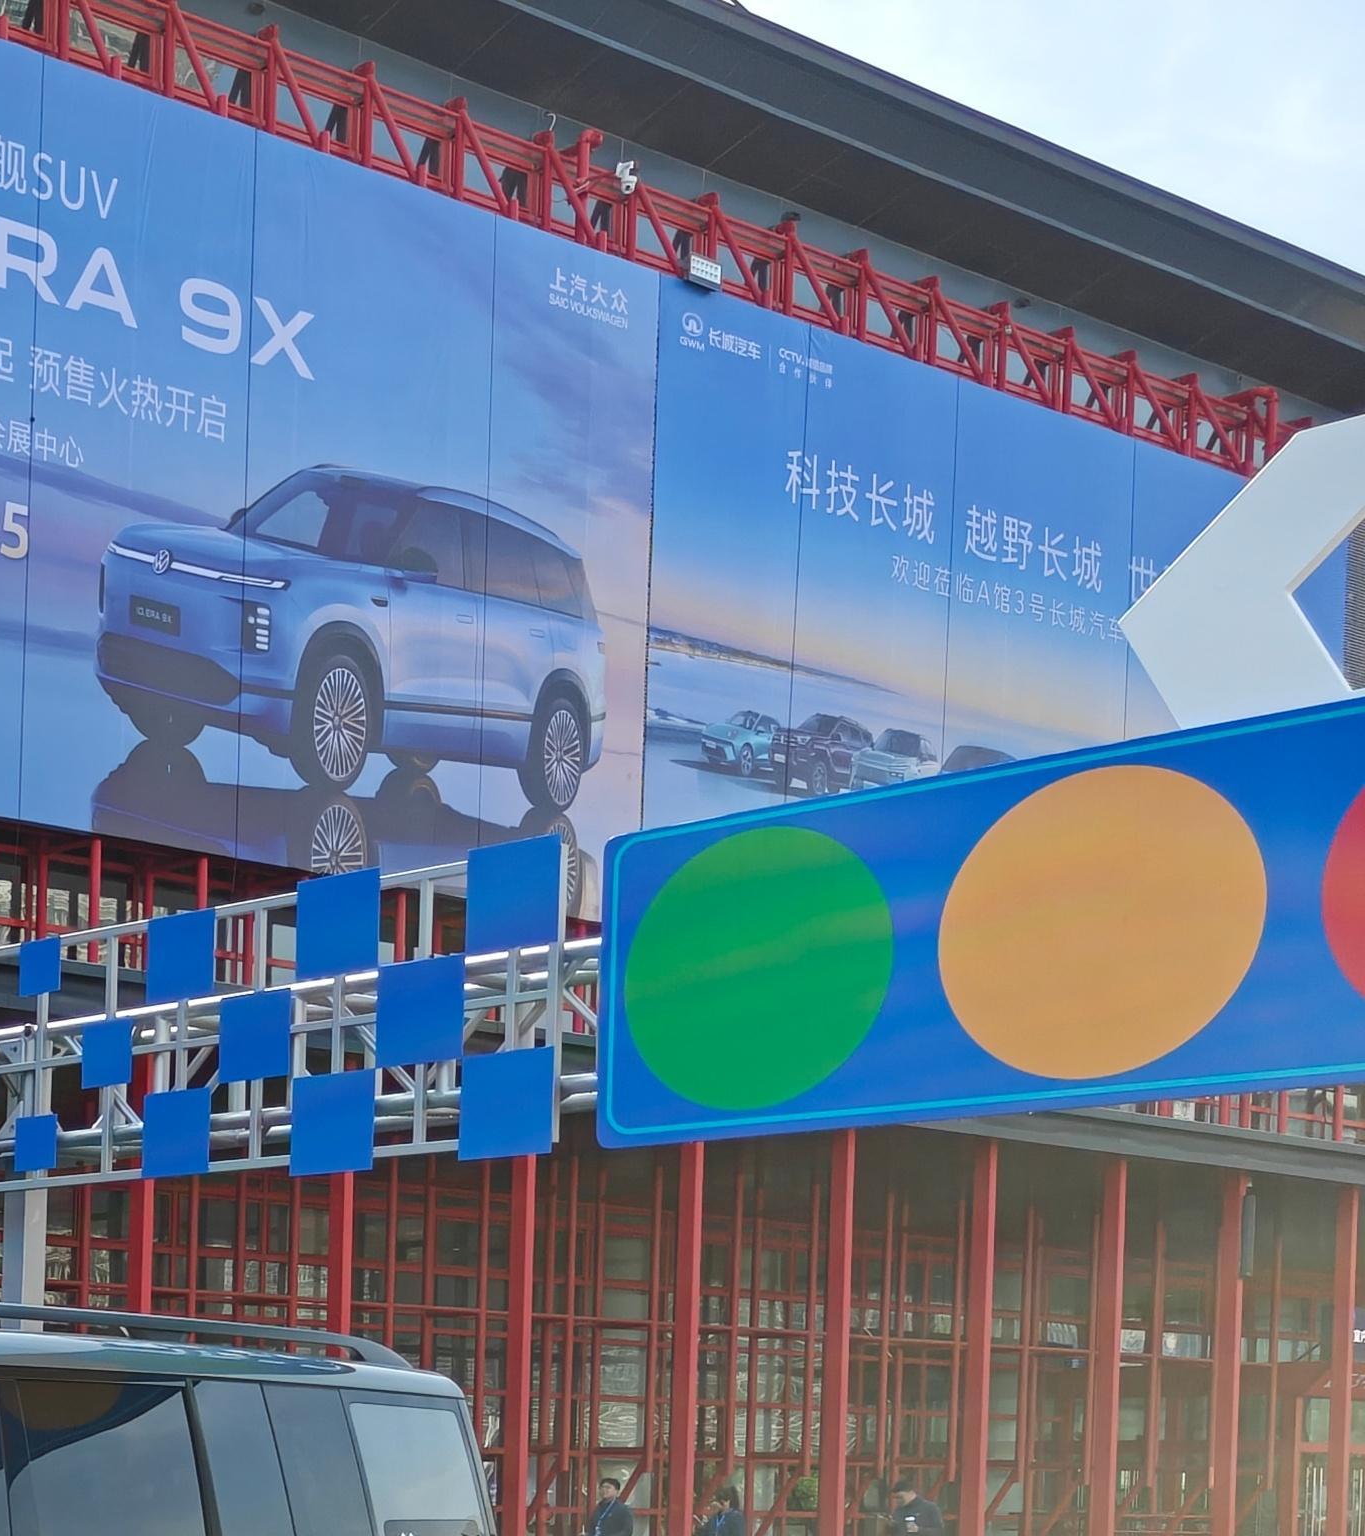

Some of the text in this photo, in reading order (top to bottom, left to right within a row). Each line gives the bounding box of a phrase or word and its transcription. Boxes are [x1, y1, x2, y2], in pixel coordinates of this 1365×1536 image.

[549, 266, 628, 315] 上汽大众
[570, 299, 629, 329] VOLKSWAGEN
[178, 278, 316, 381] 9X
[679, 335, 706, 353] GWM
[708, 327, 762, 361] 长城汽车
[27, 352, 228, 444] 预售火热开启
[785, 450, 1170, 602] 科技长城 越野长城 世
[891, 554, 1125, 643] 欢迎莅临A馆3号长城汽车
